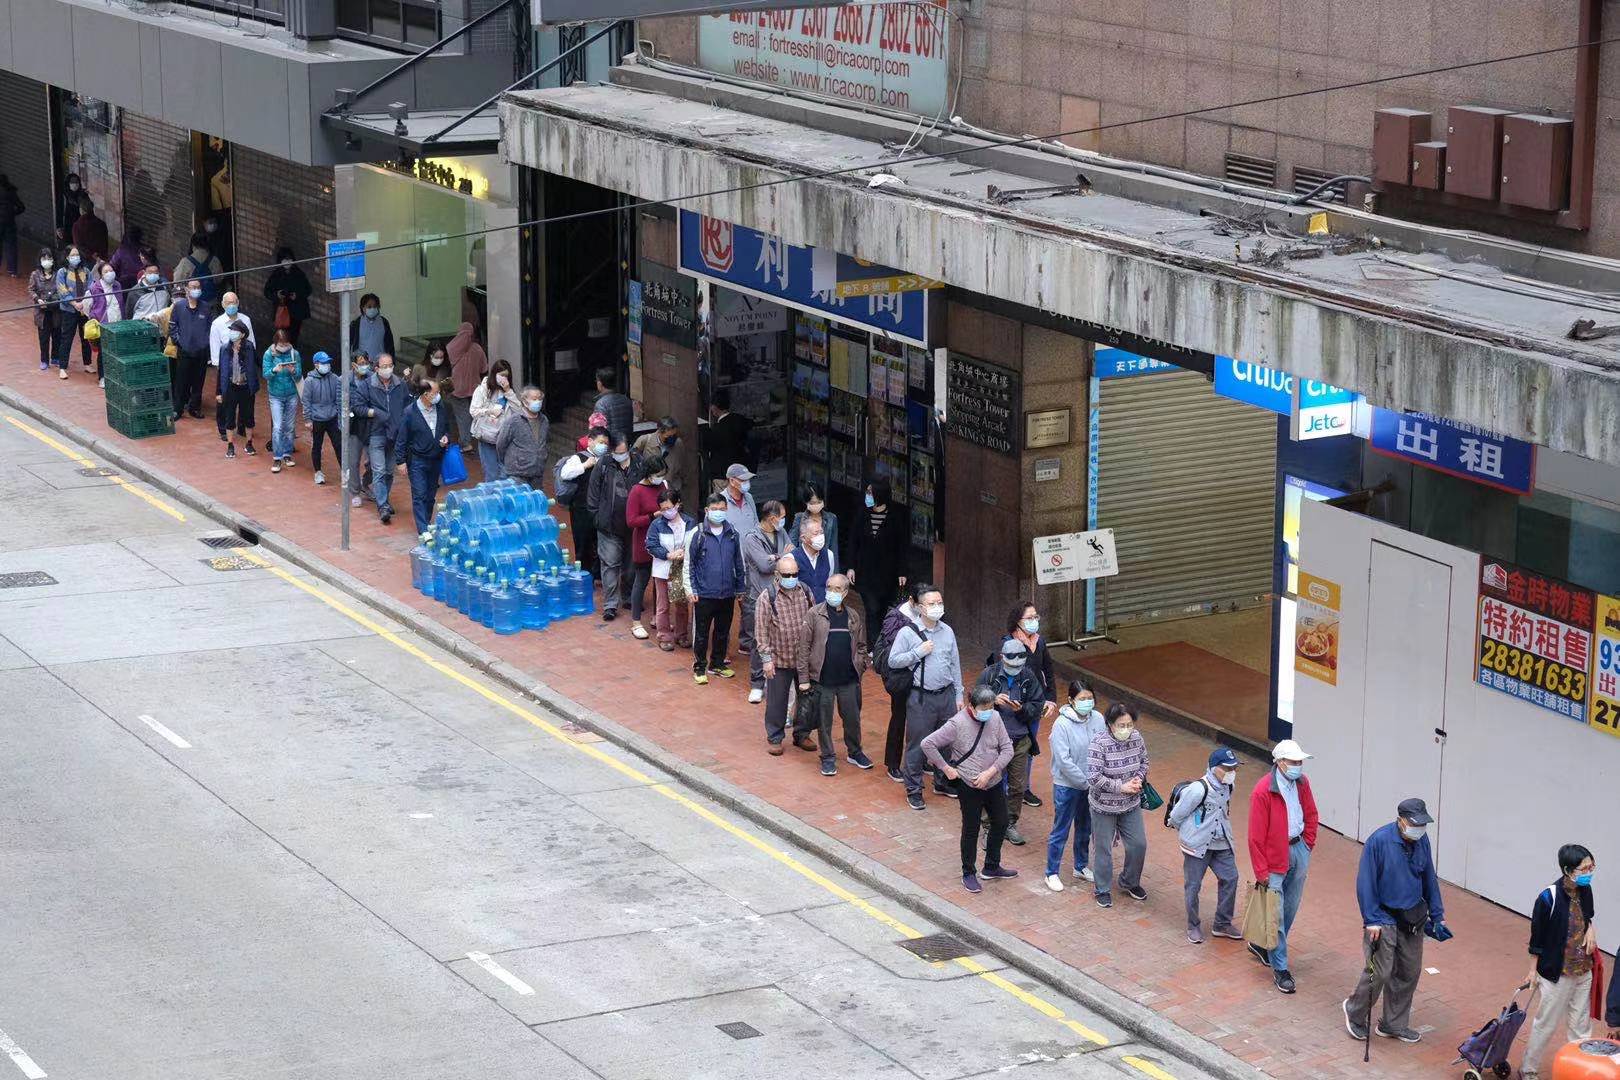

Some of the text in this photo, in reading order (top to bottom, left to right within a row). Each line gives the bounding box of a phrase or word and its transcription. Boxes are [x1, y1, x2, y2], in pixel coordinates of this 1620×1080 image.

[733, 30, 760, 48] email
[769, 33, 910, 77] fortresshill@ricacorp.com
[733, 58, 778, 81] website
[790, 69, 909, 108] www.ricacorp.com
[640, 301, 692, 330] Fortress Tower
[948, 387, 1009, 418] Fortress Tower
[987, 436, 1010, 451] ROAD
[1396, 419, 1505, 480] 出租
[1507, 571, 1592, 626] 金時物業
[1483, 600, 1588, 671] 特約租售
[1481, 640, 1586, 701] 28381633
[1481, 668, 1583, 720] 各區物業旺舖租售
